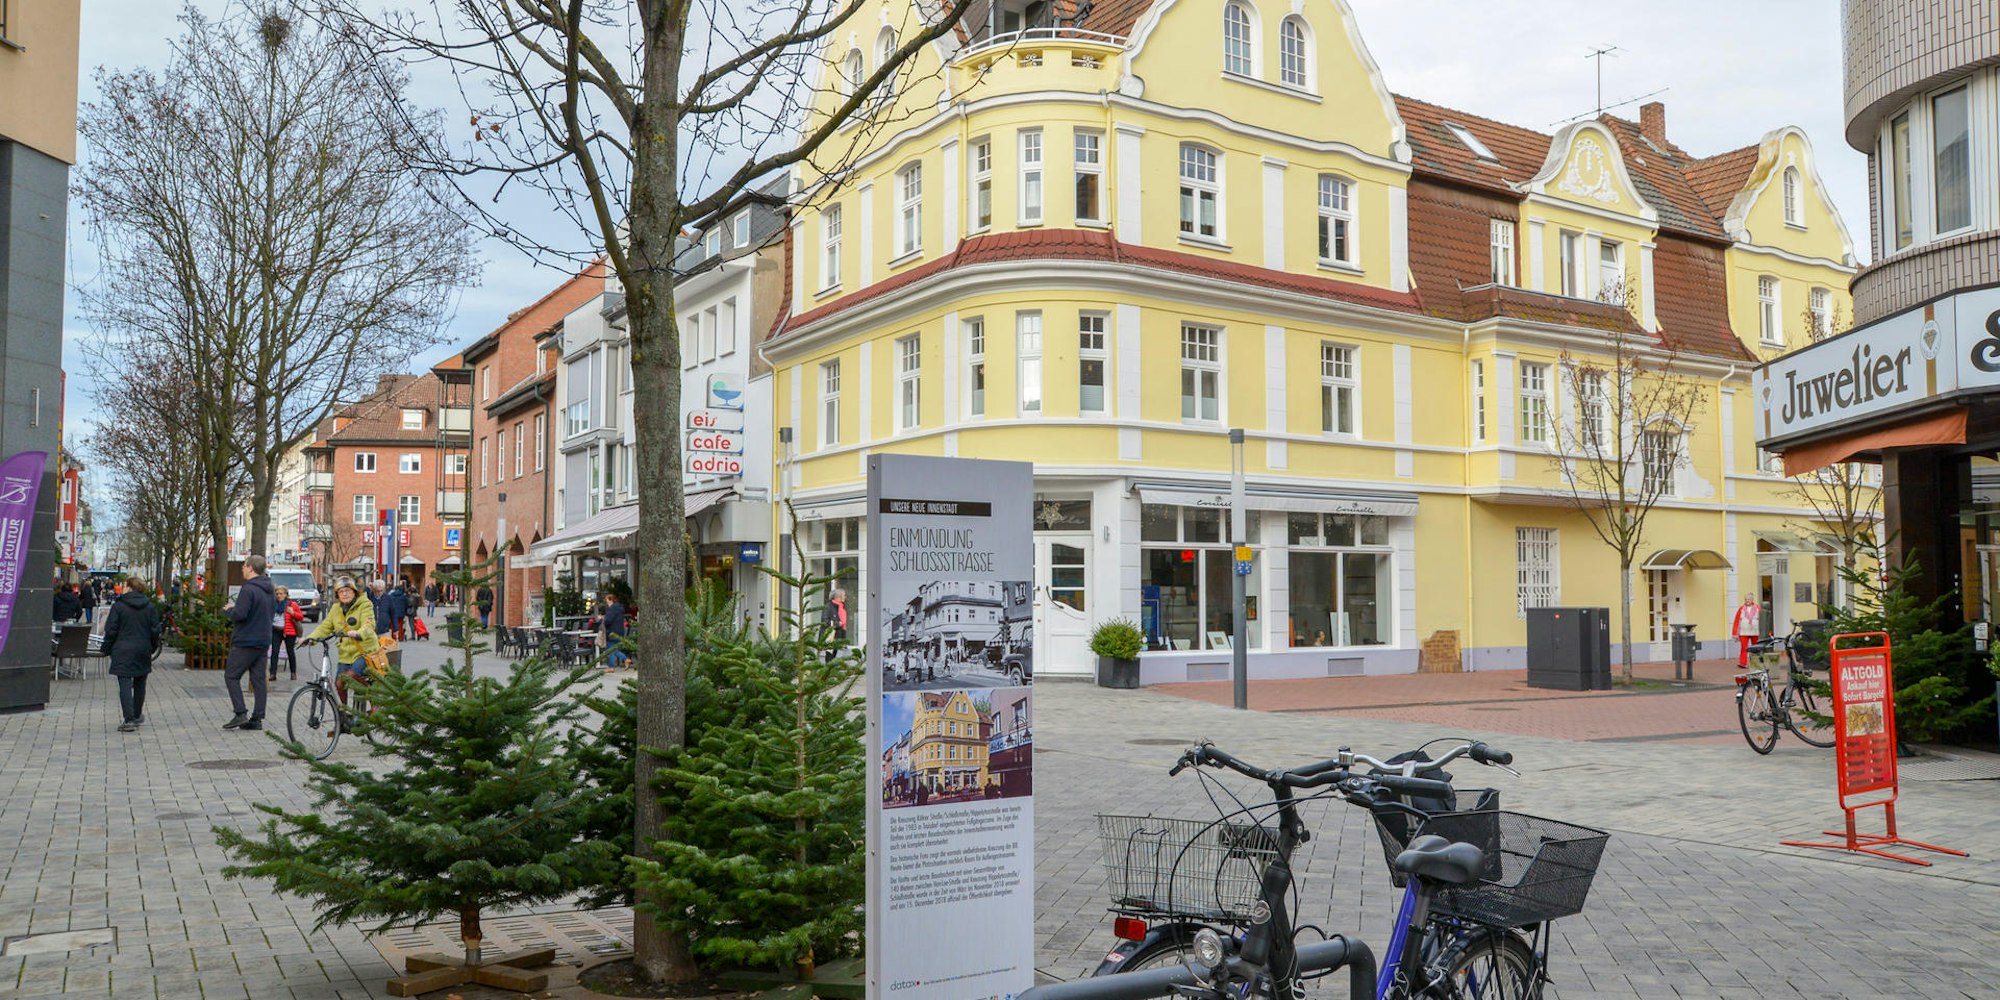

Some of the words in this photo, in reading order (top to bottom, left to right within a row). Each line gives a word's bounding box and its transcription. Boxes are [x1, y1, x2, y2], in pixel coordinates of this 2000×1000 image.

[1782, 343, 1912, 424] Juwelier
[693, 412, 717, 427] eis
[693, 434, 731, 450] cafe
[692, 457, 740, 473] adria
[890, 502, 910, 512] UNSERE
[912, 502, 926, 513] NEUE
[927, 503, 958, 514] INNENSTADT
[5, 519, 20, 560] KULTUR
[890, 526, 974, 549] EINMÜNDUNG
[890, 551, 995, 572] SCHLOSSSTRASSE
[4, 561, 16, 594] KAFFEE
[1842, 665, 1884, 680] ALTGOLD
[1843, 692, 1862, 702] Sofort
[890, 980, 916, 991] datax
